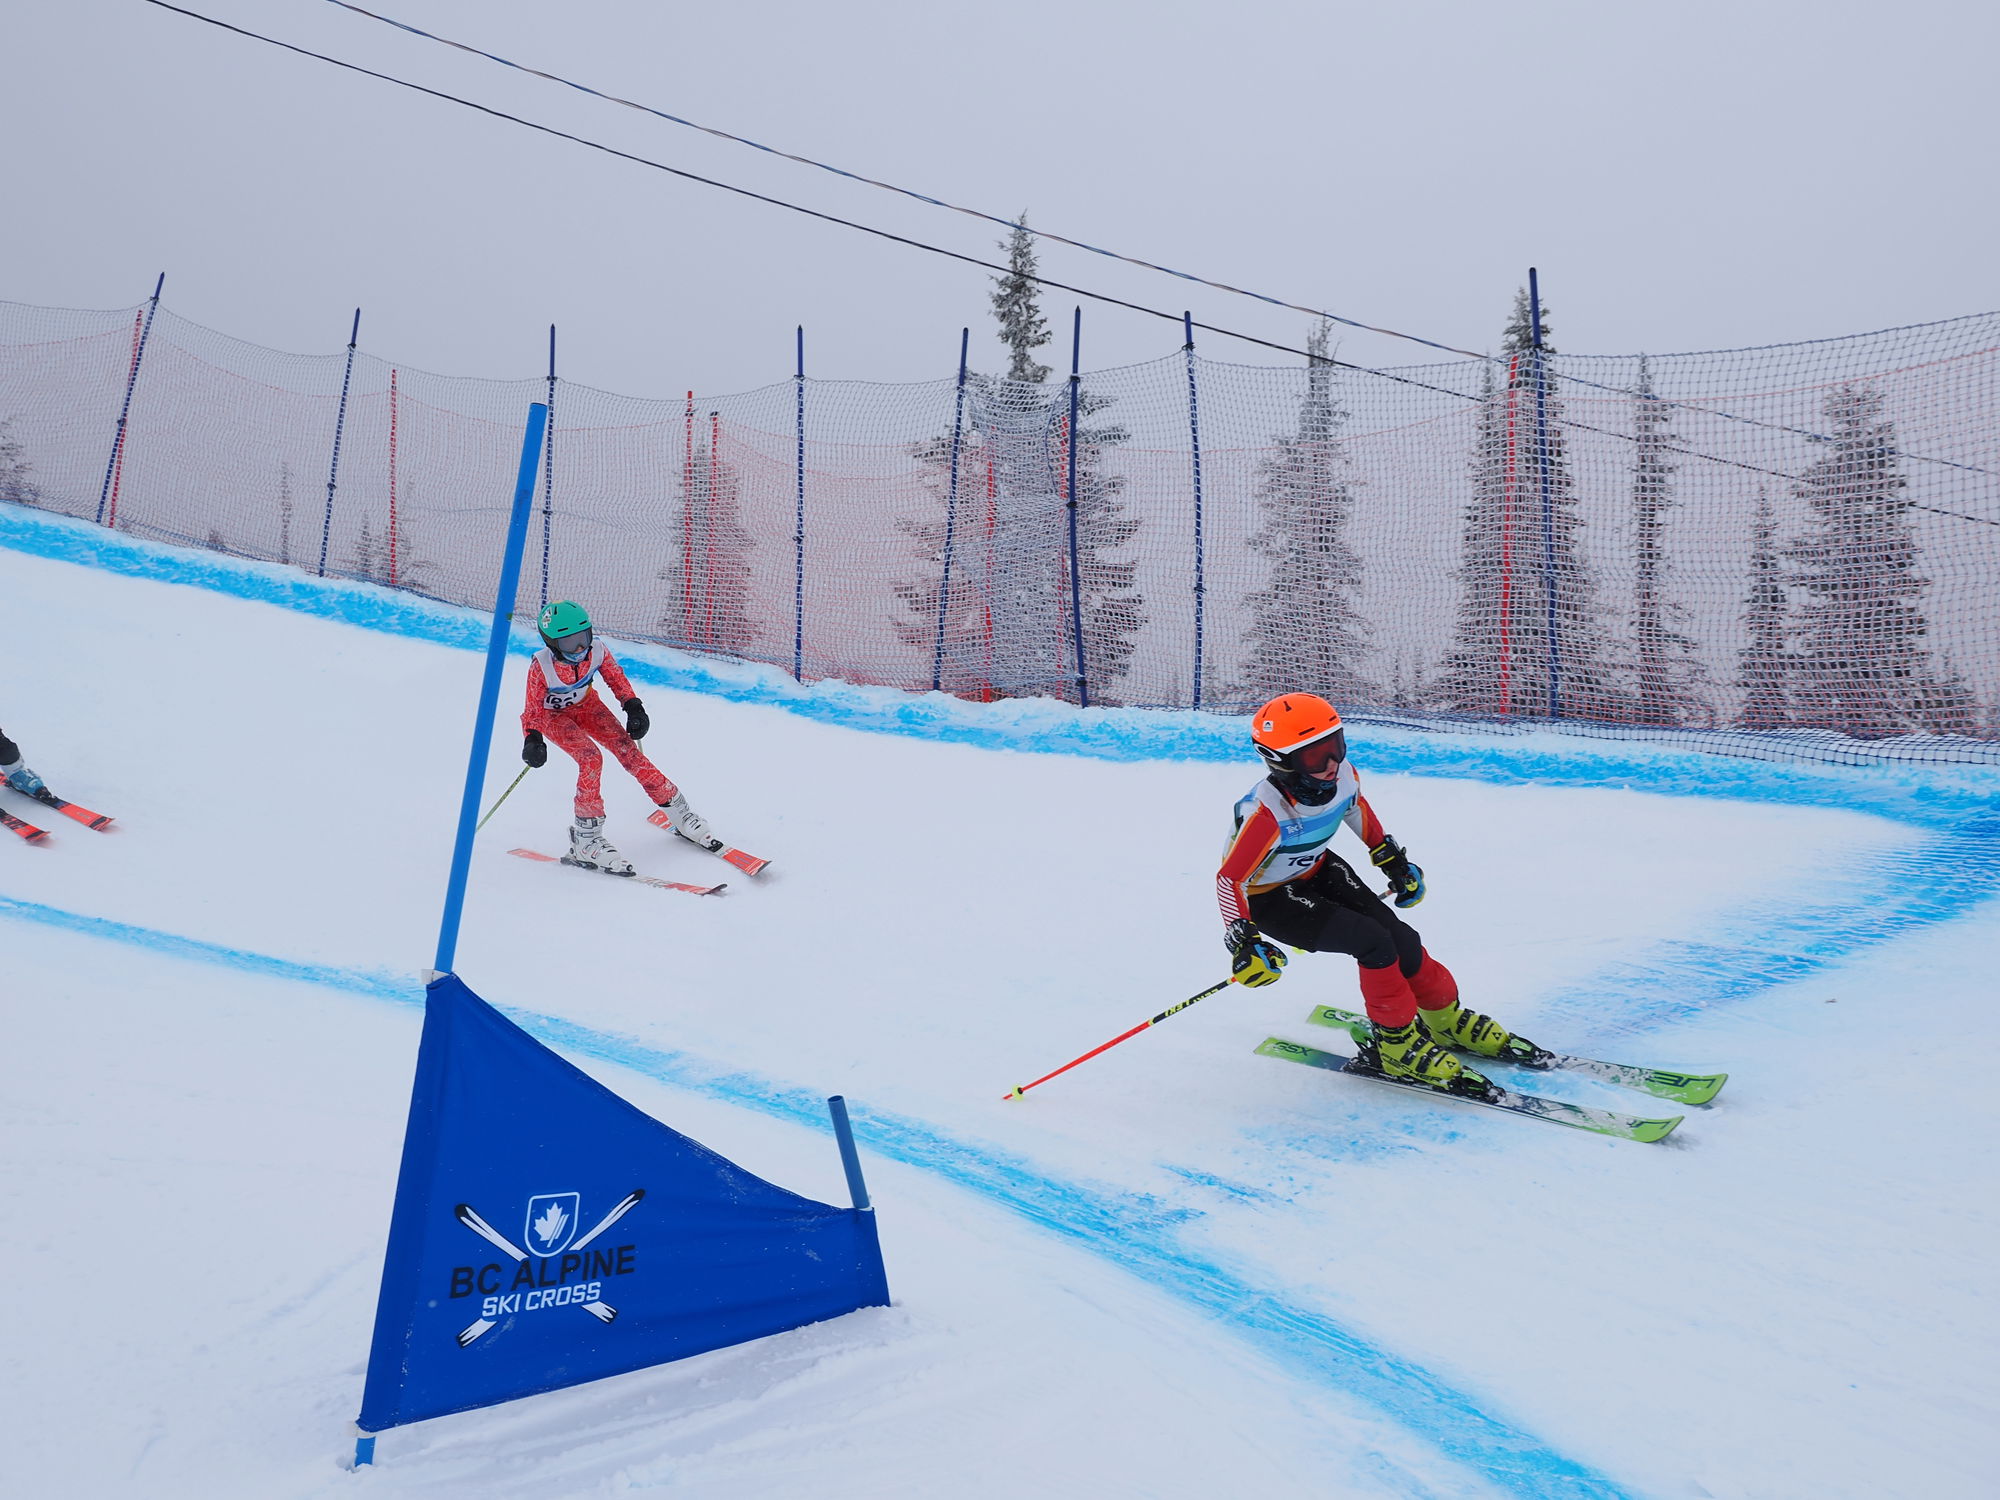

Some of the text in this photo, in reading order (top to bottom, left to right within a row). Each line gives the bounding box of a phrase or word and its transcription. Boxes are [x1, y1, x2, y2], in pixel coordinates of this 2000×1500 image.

[450, 1244, 636, 1298] BC ALPINE
[482, 1281, 601, 1316] SKI CROSS
